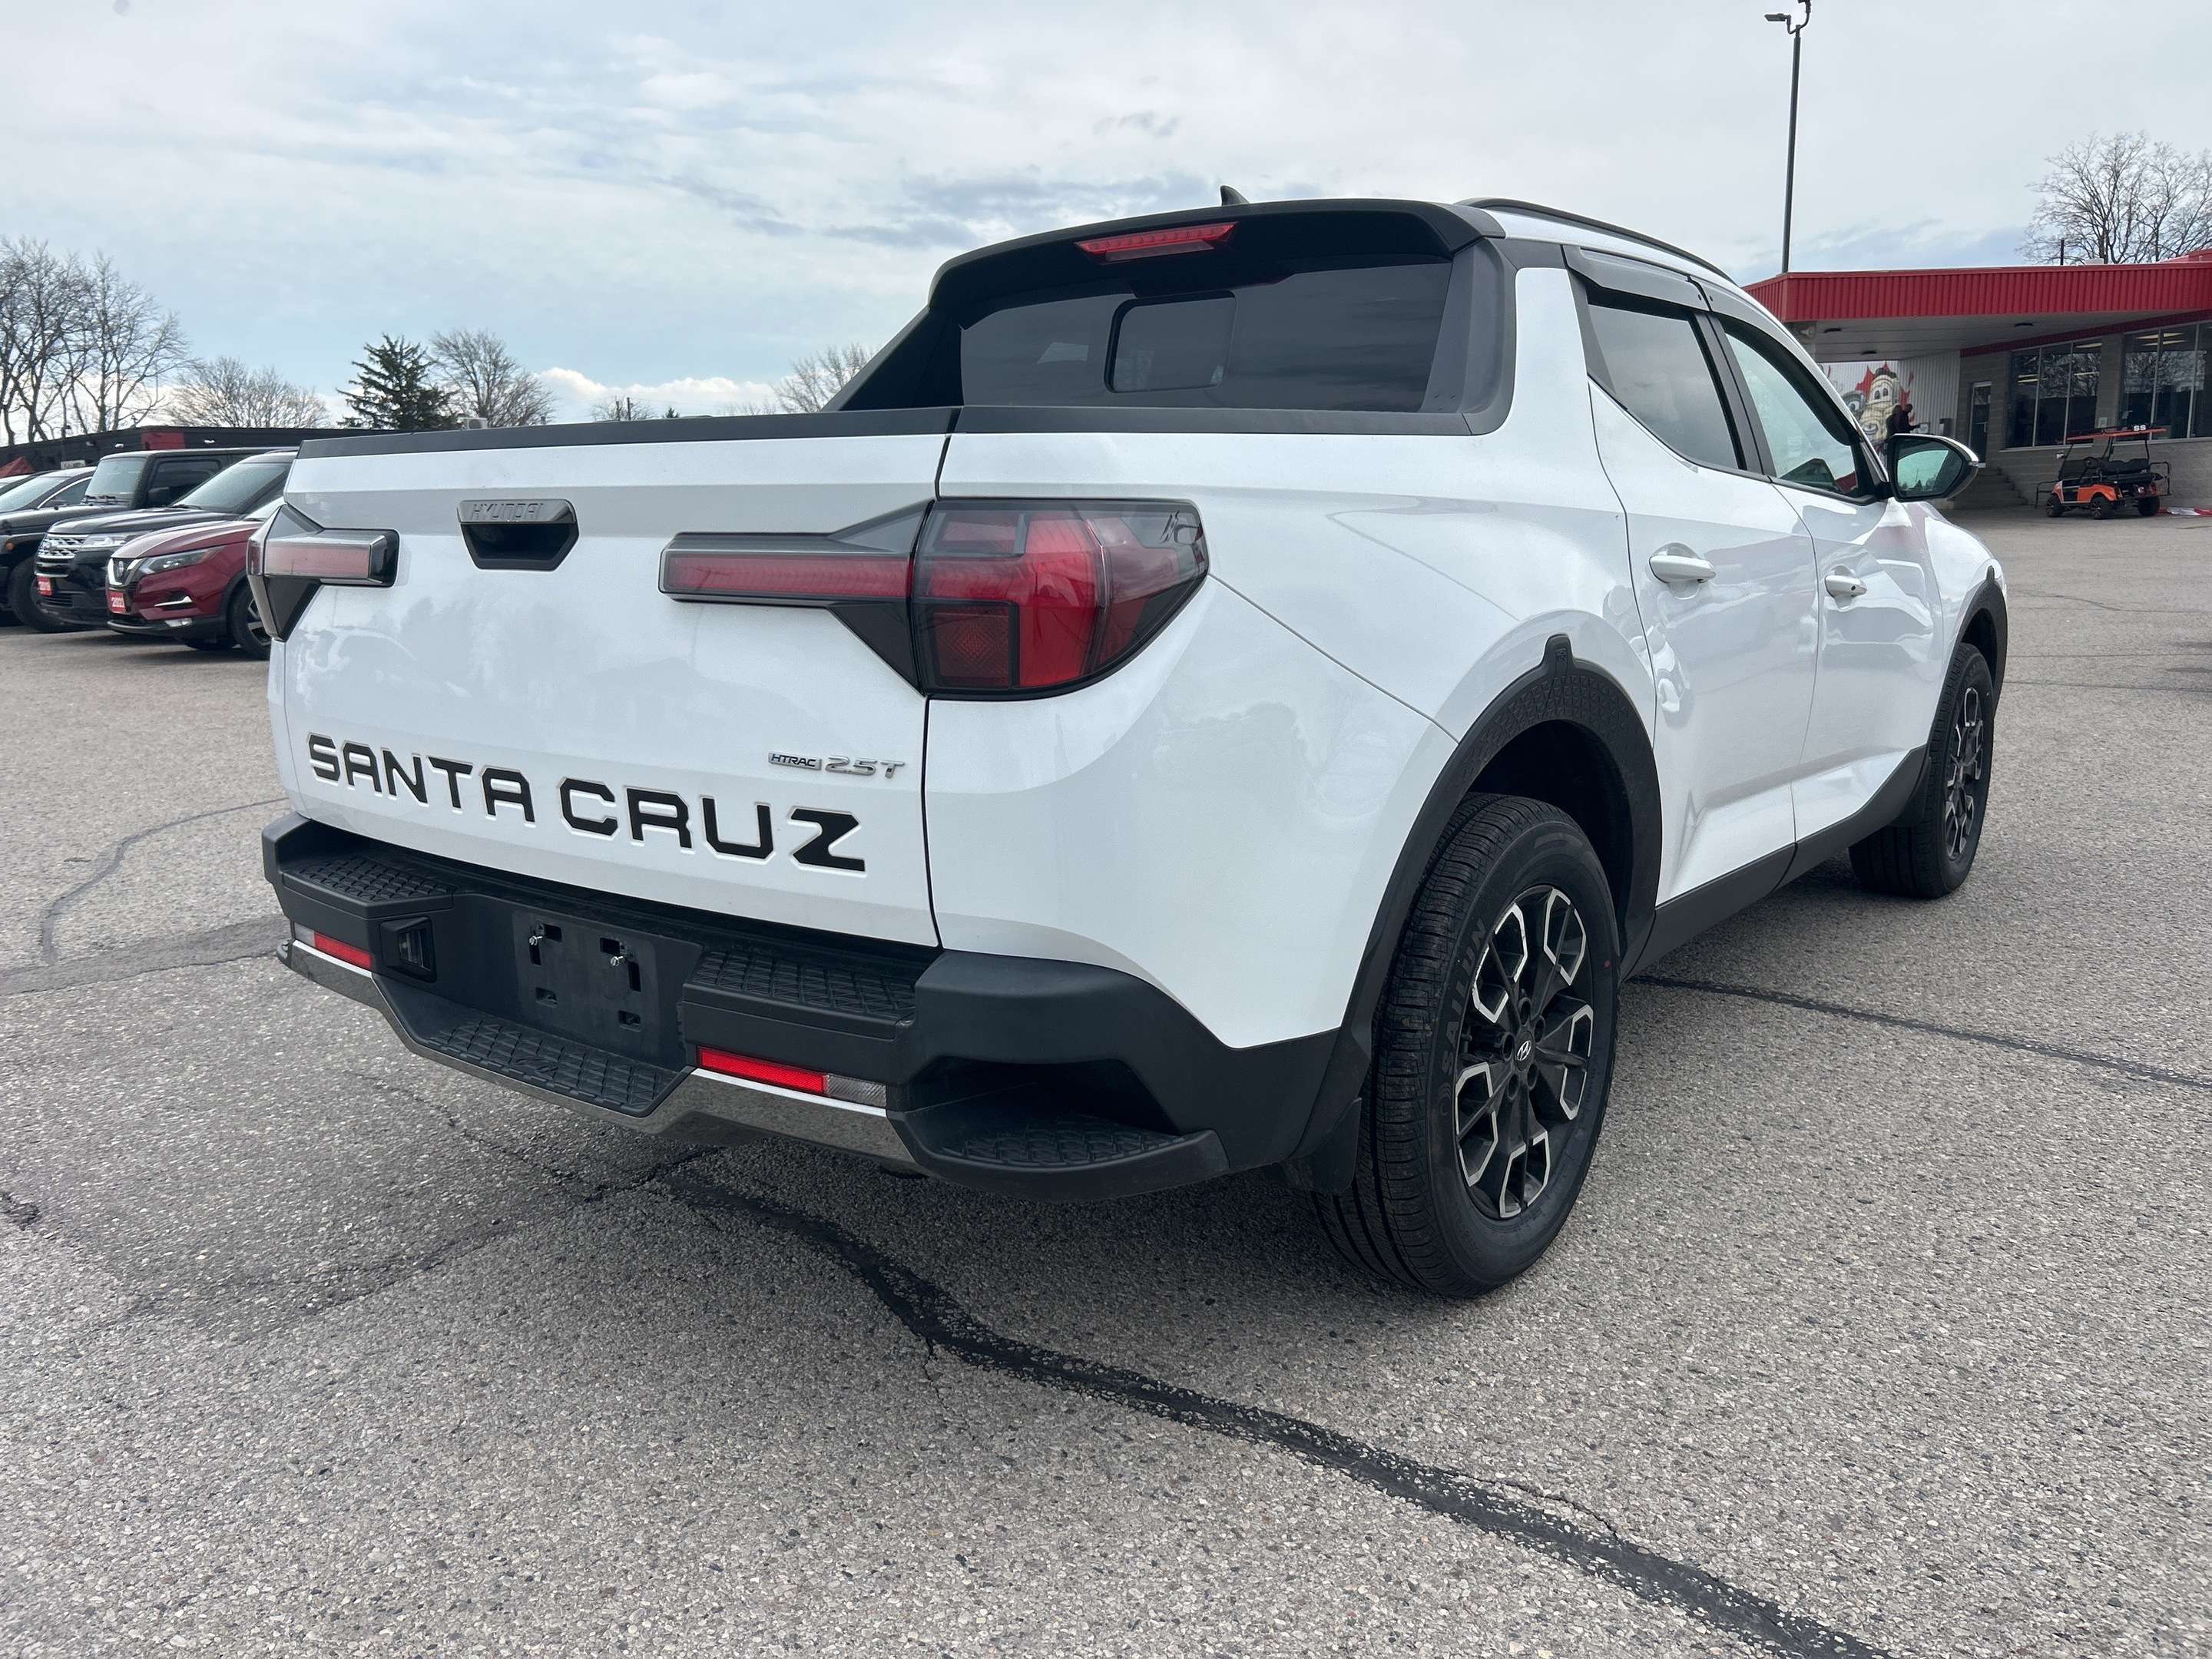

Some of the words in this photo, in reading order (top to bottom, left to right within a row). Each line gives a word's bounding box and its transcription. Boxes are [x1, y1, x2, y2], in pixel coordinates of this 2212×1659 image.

[472, 503, 544, 522] HYUNDAI
[771, 753, 816, 767] HTRAC
[307, 733, 536, 824] SANTA
[558, 778, 866, 874] CRUZ
